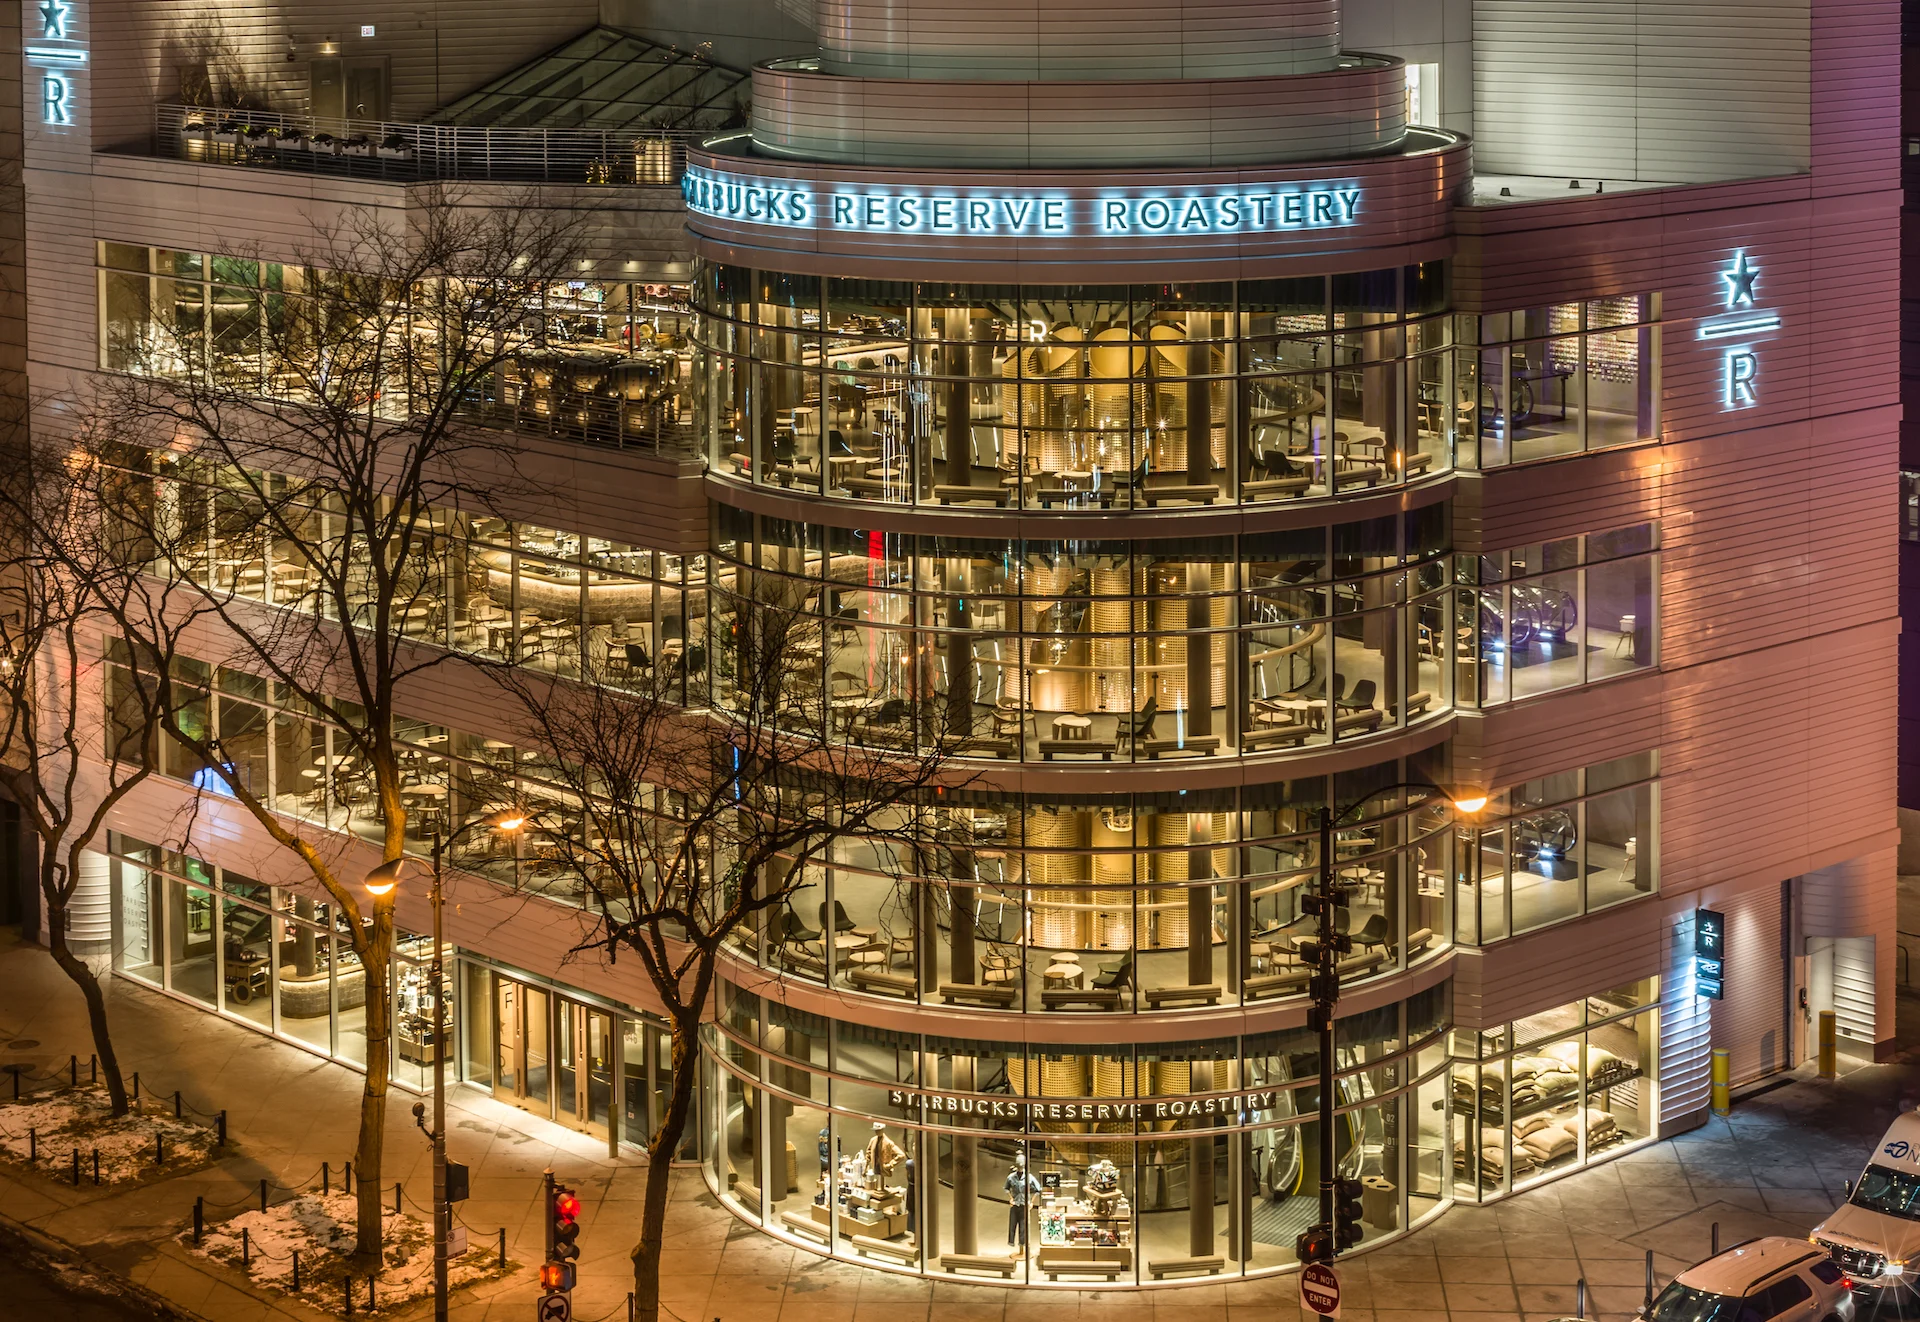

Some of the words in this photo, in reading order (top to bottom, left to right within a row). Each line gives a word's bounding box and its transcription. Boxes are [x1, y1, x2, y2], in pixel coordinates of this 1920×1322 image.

[43, 76, 66, 121] R
[834, 195, 1064, 230] RESERVE
[1105, 191, 1360, 229] ROASTERY
[1029, 319, 1047, 342] R
[1730, 352, 1758, 404] R
[1704, 935, 1714, 948] R
[1385, 1067, 1395, 1077] 04
[1032, 1104, 1142, 1119] RESERVE
[1386, 1113, 1395, 1123] 02
[1387, 1136, 1396, 1146] 01
[1306, 1271, 1317, 1281] DO
[1320, 1275, 1335, 1286] NOT
[1309, 1293, 1332, 1307] ENTER
